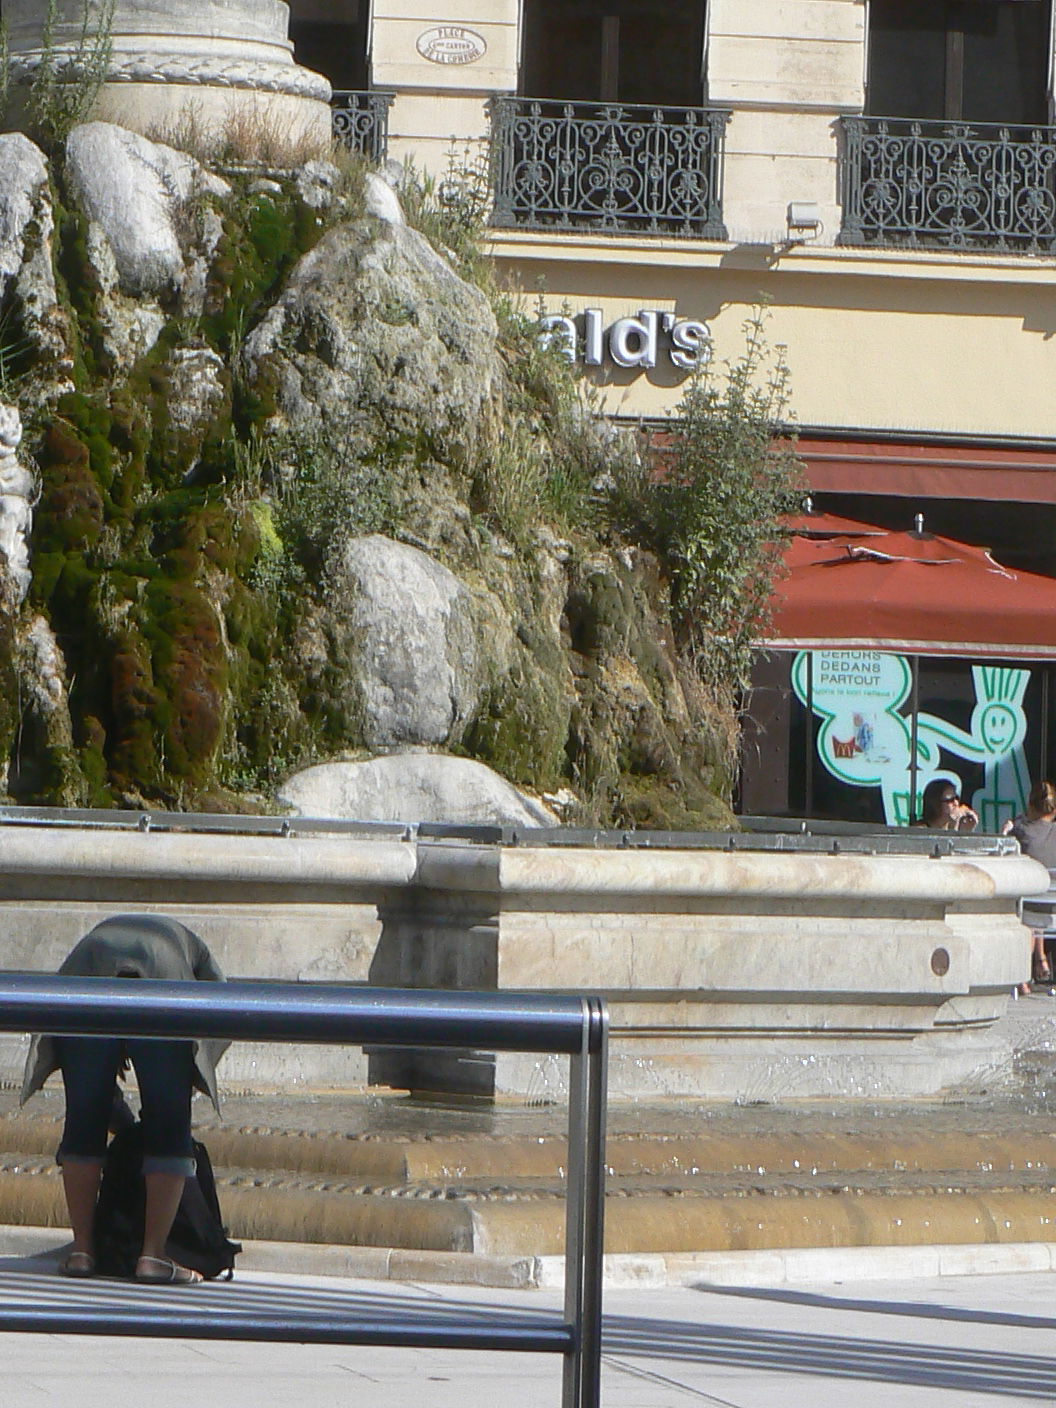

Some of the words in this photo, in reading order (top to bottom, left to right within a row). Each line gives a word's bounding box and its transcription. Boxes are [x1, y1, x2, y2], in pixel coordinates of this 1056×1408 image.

[438, 28, 464, 38] PLACE
[821, 660, 881, 673] DEDANS
[820, 674, 881, 685] PARTOUT
